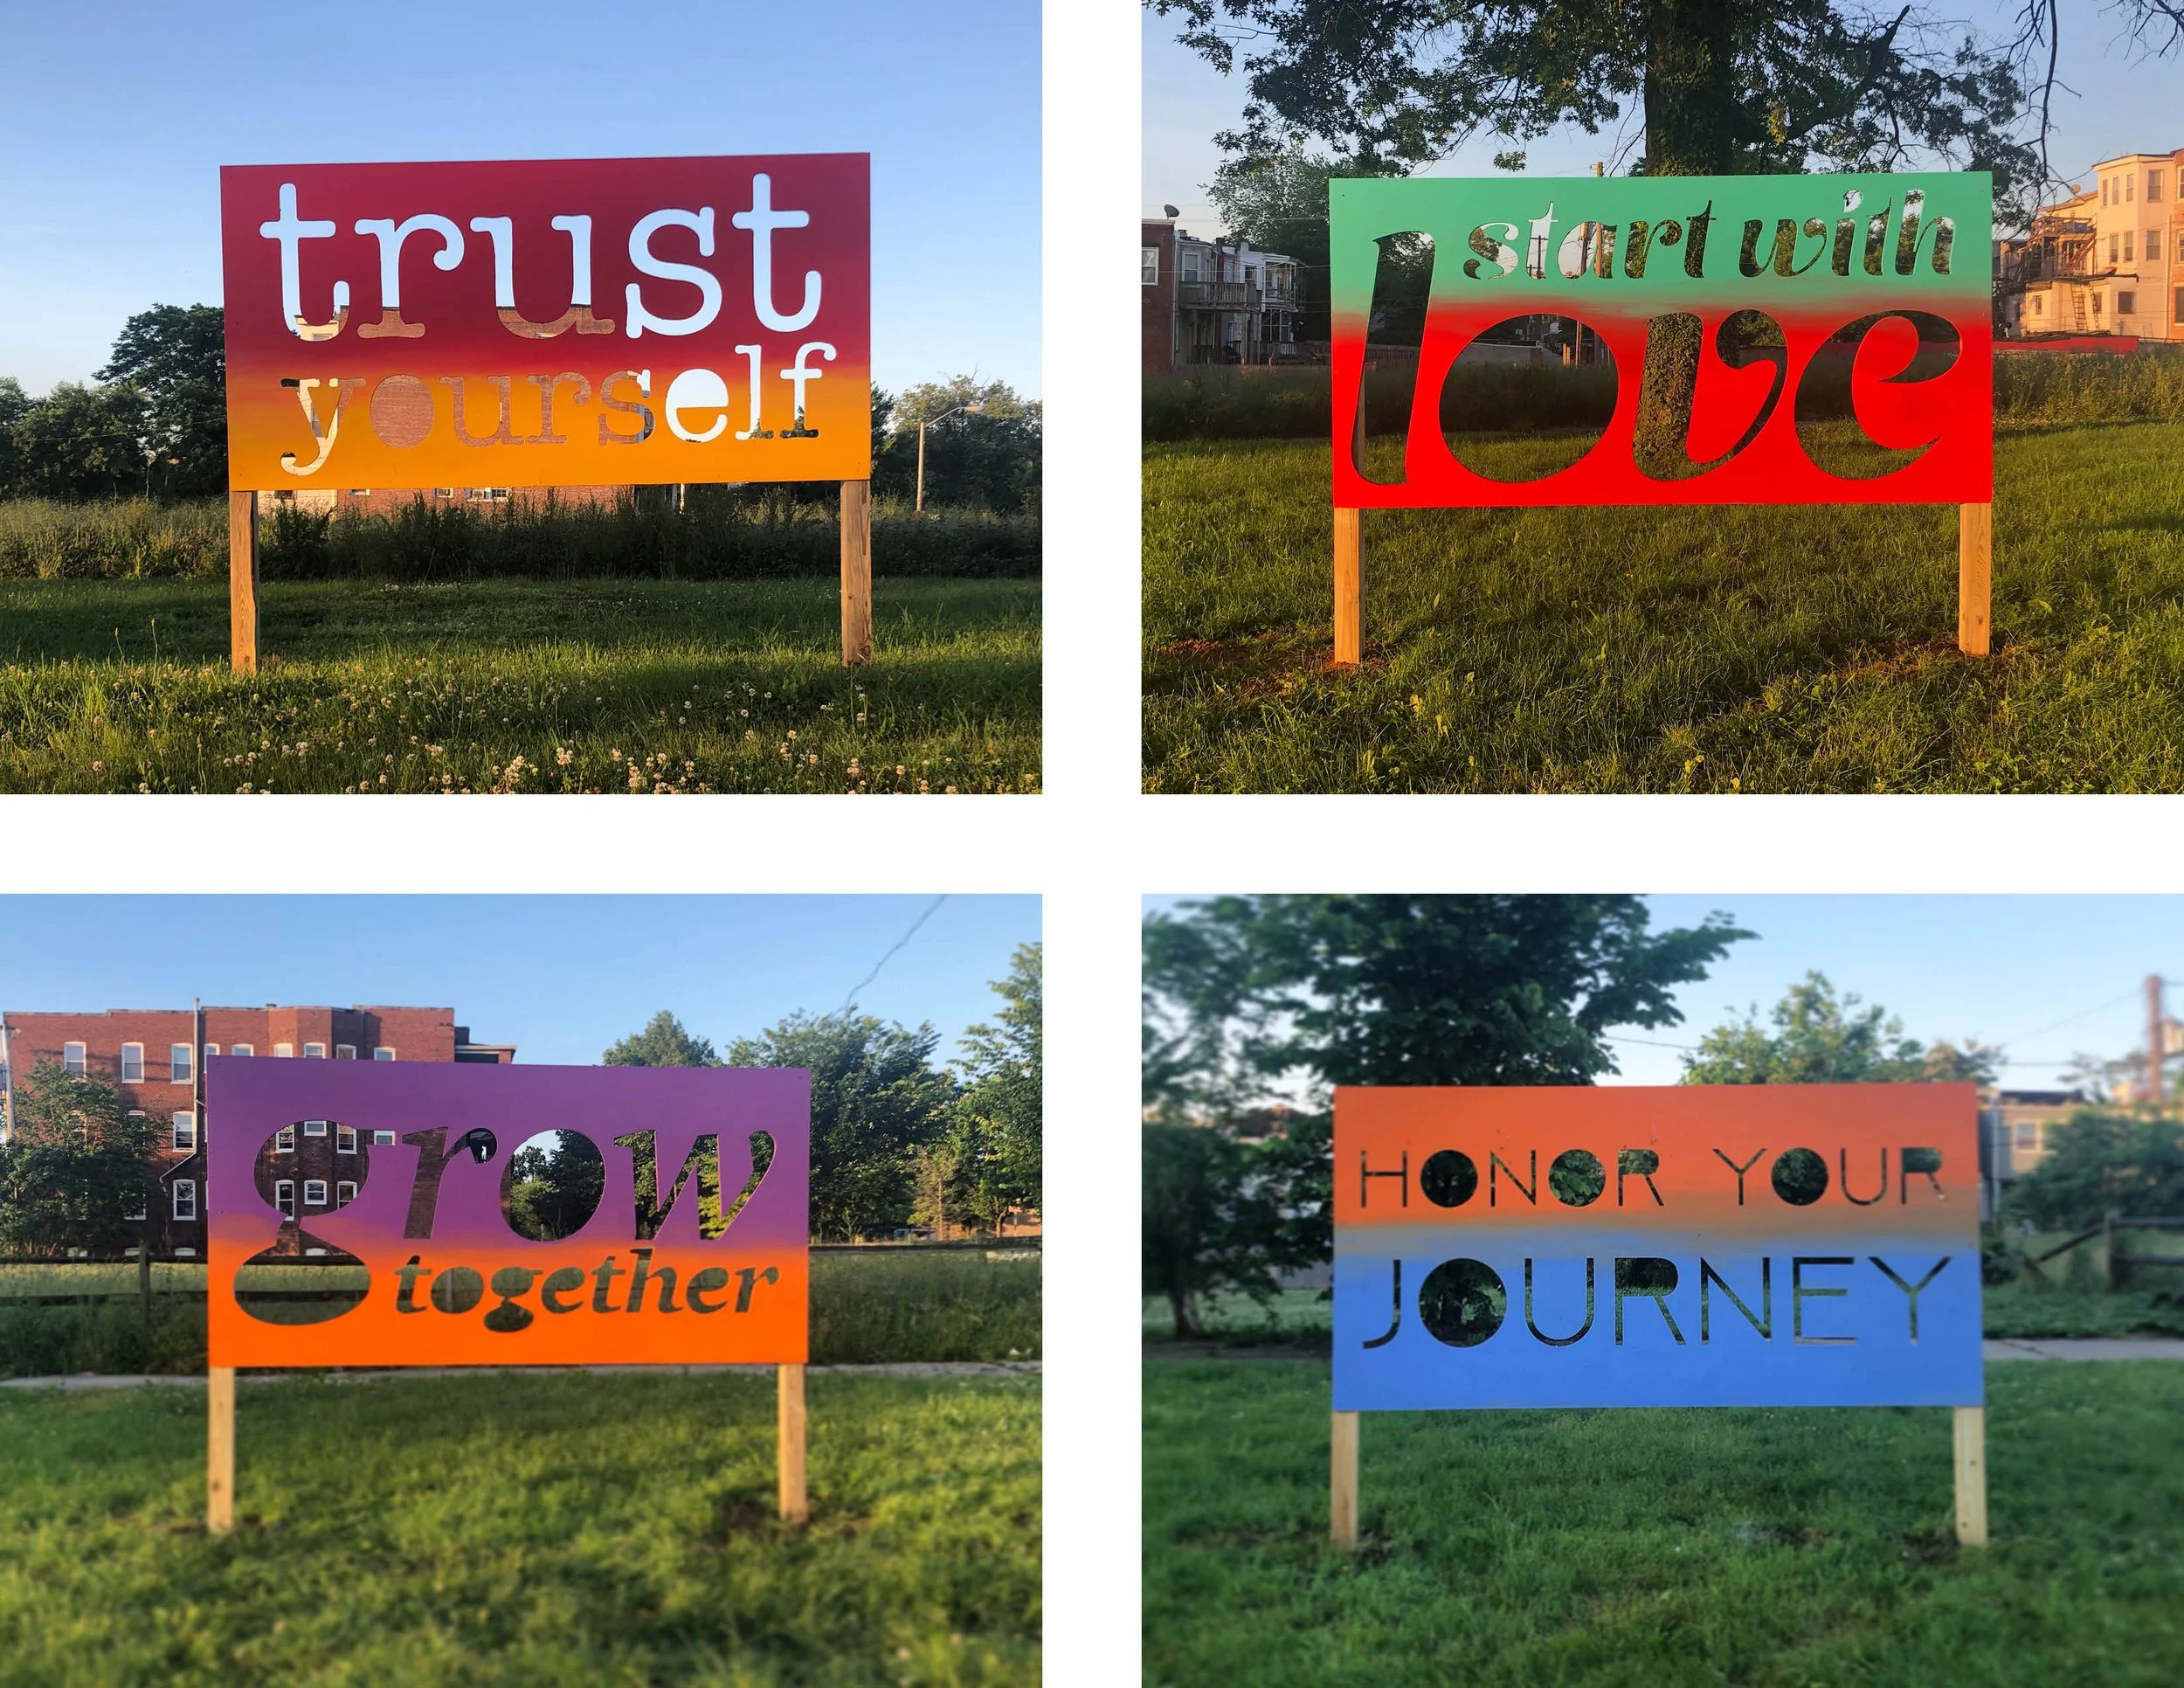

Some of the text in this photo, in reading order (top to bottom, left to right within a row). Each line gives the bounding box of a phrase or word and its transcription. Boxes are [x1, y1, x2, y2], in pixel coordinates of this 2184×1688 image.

[259, 173, 822, 342] trust
[1463, 189, 1957, 280] start with
[280, 342, 837, 476] yourself
[1351, 230, 1964, 486] love
[233, 1119, 778, 1326] grow
[1360, 1146, 1949, 1208] HONOR YOUR
[395, 1248, 781, 1333] together
[1362, 1256, 1952, 1349] JOURNEY
